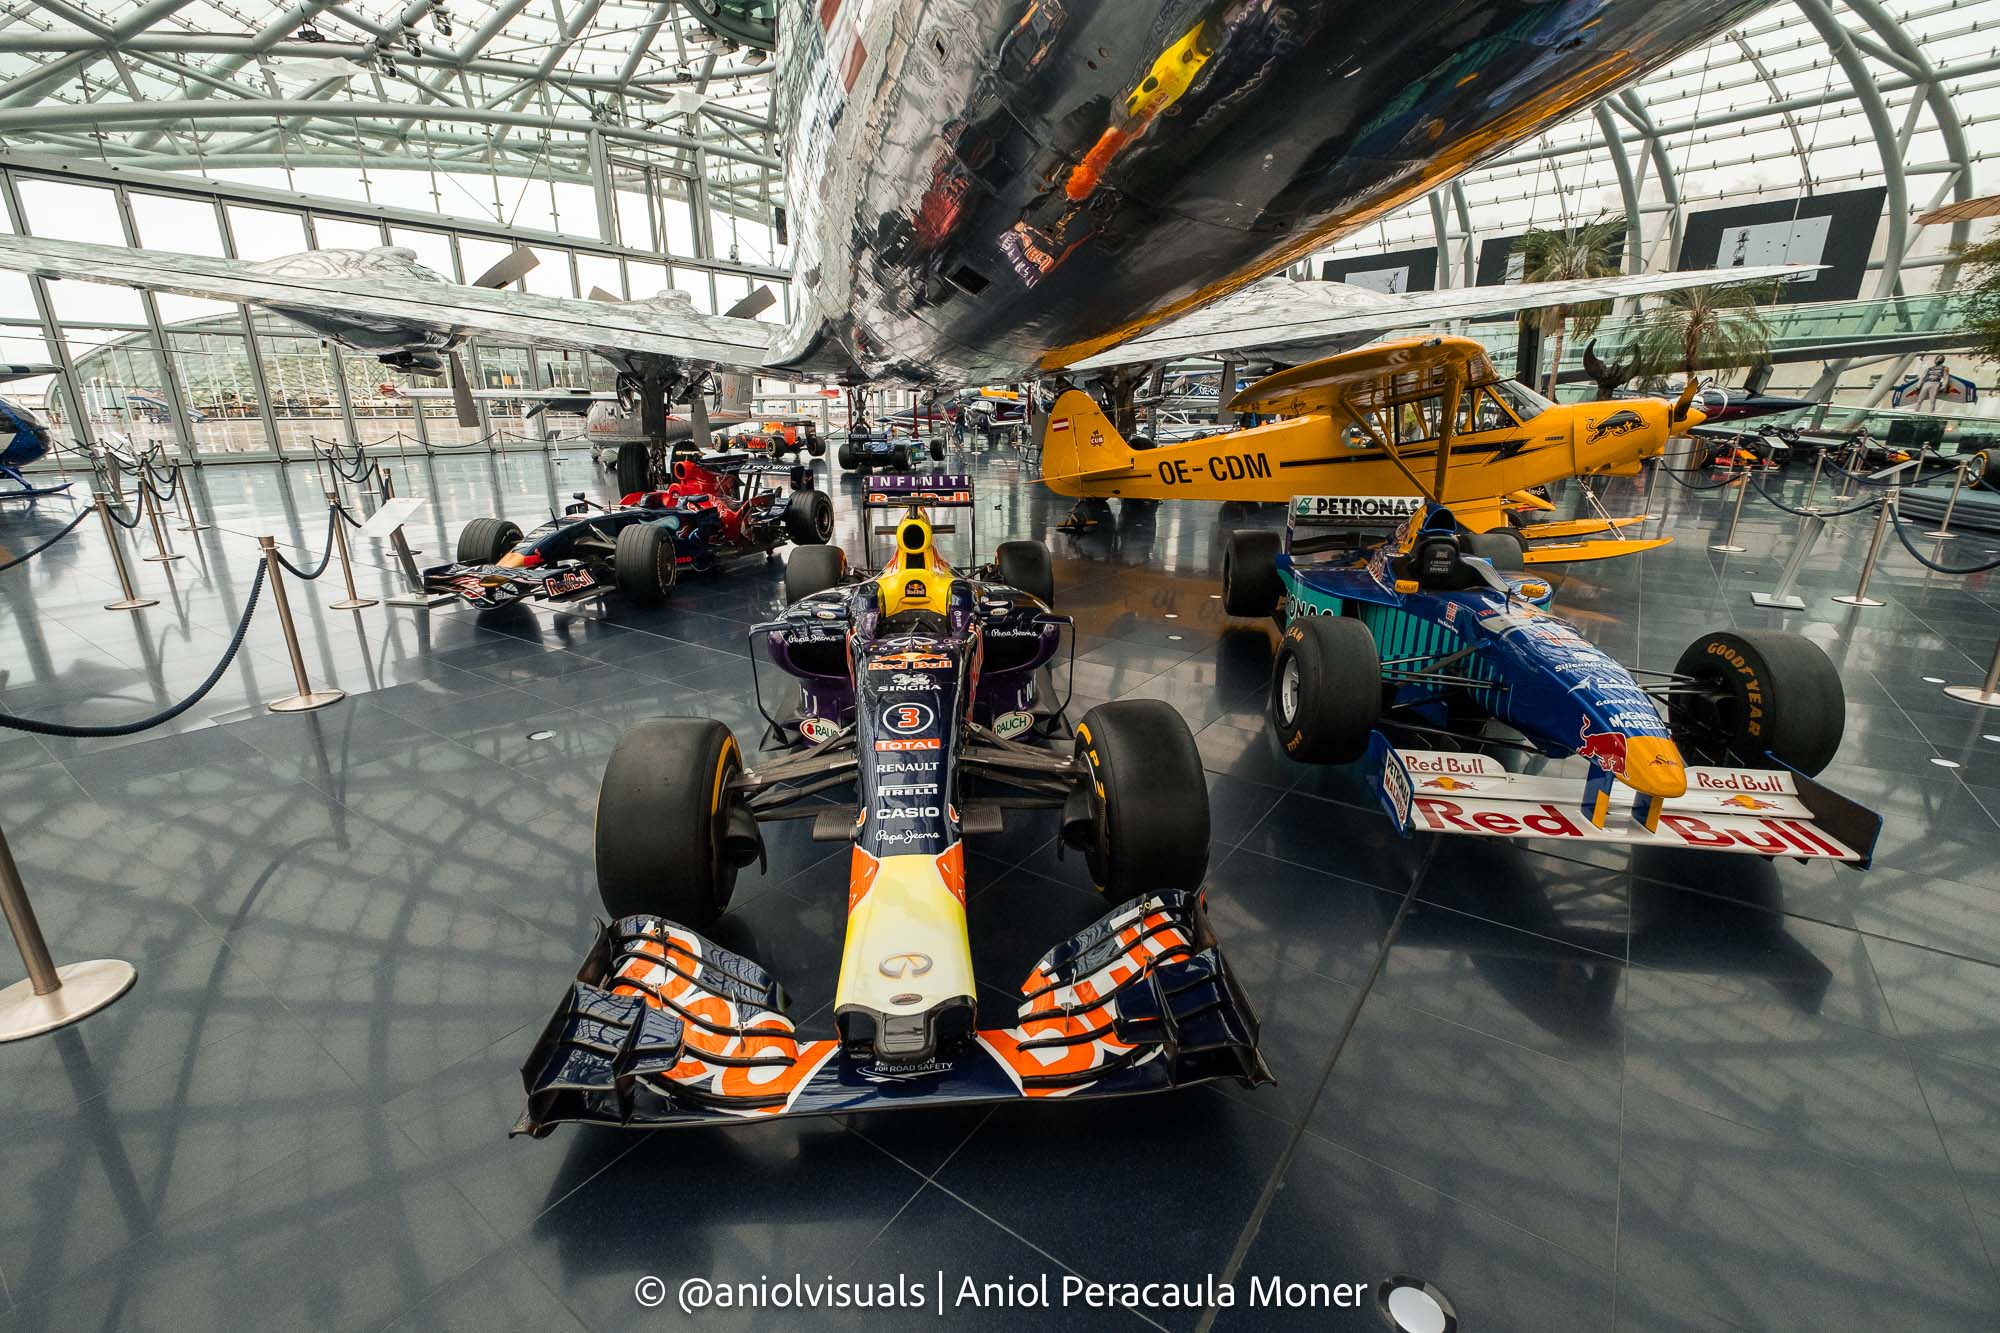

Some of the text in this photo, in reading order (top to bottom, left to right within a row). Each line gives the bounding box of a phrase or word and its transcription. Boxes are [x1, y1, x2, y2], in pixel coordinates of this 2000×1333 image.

[869, 476, 969, 487] INFINITI
[1317, 498, 1420, 515] PETRONAS
[788, 634, 838, 644] Pepe Jeans
[991, 628, 1041, 638] Pepe Jeans
[868, 660, 953, 671] Red Bull
[1706, 642, 1763, 736] GOODYEAR
[898, 708, 920, 728] 3
[997, 715, 1027, 735] RAUCH
[878, 740, 939, 751] TOTAL
[877, 762, 940, 773] RENAULT
[1405, 756, 1484, 774] Red Bull
[1697, 771, 1784, 792] Red Bull
[878, 784, 938, 796] PIRELLI
[877, 807, 940, 820] CASIO
[1414, 798, 1845, 857] Red Bull
[876, 829, 940, 844] Pepe Jeans
[889, 1064, 916, 1073] ROAD
[917, 1062, 953, 1071] SAFETY
